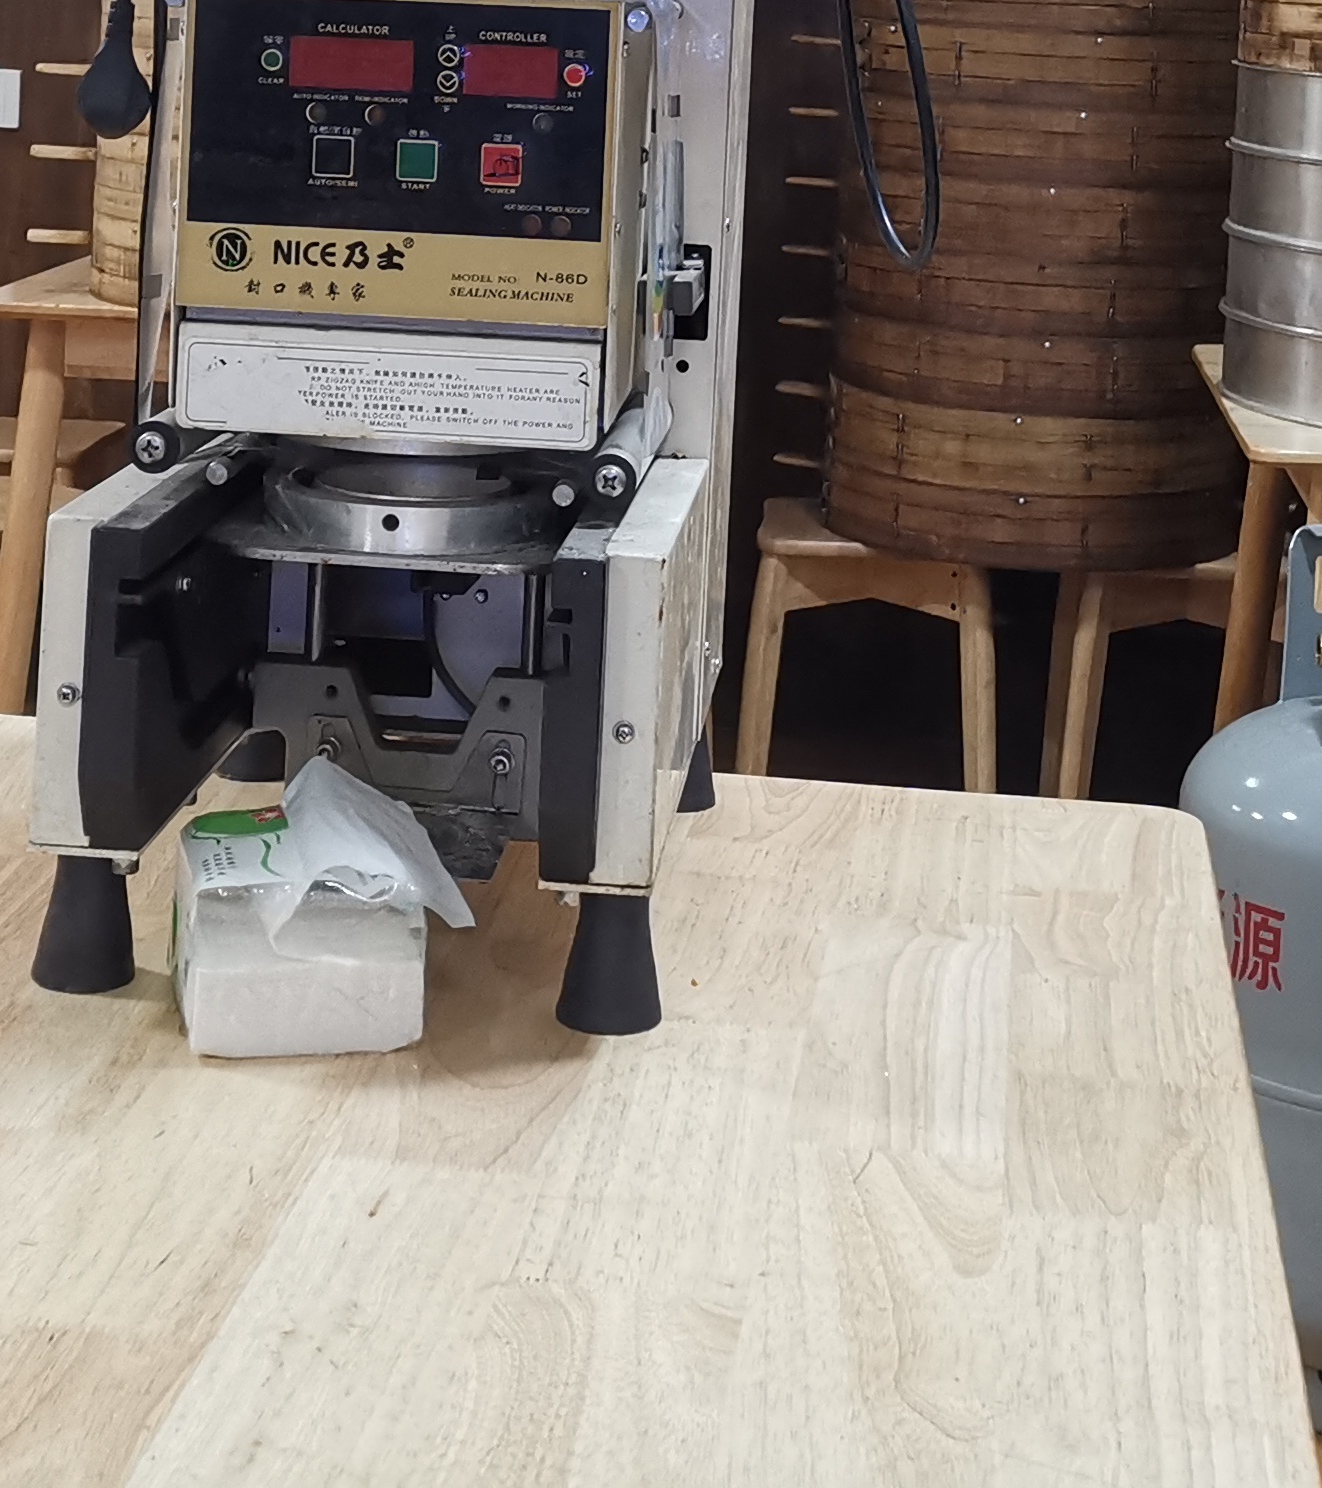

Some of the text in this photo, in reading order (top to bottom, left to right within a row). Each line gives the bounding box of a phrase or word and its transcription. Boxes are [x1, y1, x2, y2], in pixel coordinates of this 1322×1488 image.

[318, 23, 390, 35] CALCULATOR
[479, 31, 547, 43] CONTROLLER
[401, 182, 431, 190] START
[484, 187, 516, 195] POWER
[221, 239, 242, 261] N
[451, 273, 493, 283] MODEL
[535, 271, 588, 285] N-86D
[449, 286, 574, 303] SEALING MACHINE
[440, 383, 502, 393] TEMPERATURE
[356, 387, 395, 395] STRETCH
[546, 396, 581, 404] REASON
[409, 415, 442, 423] PLEASE
[522, 421, 553, 429] POWER
